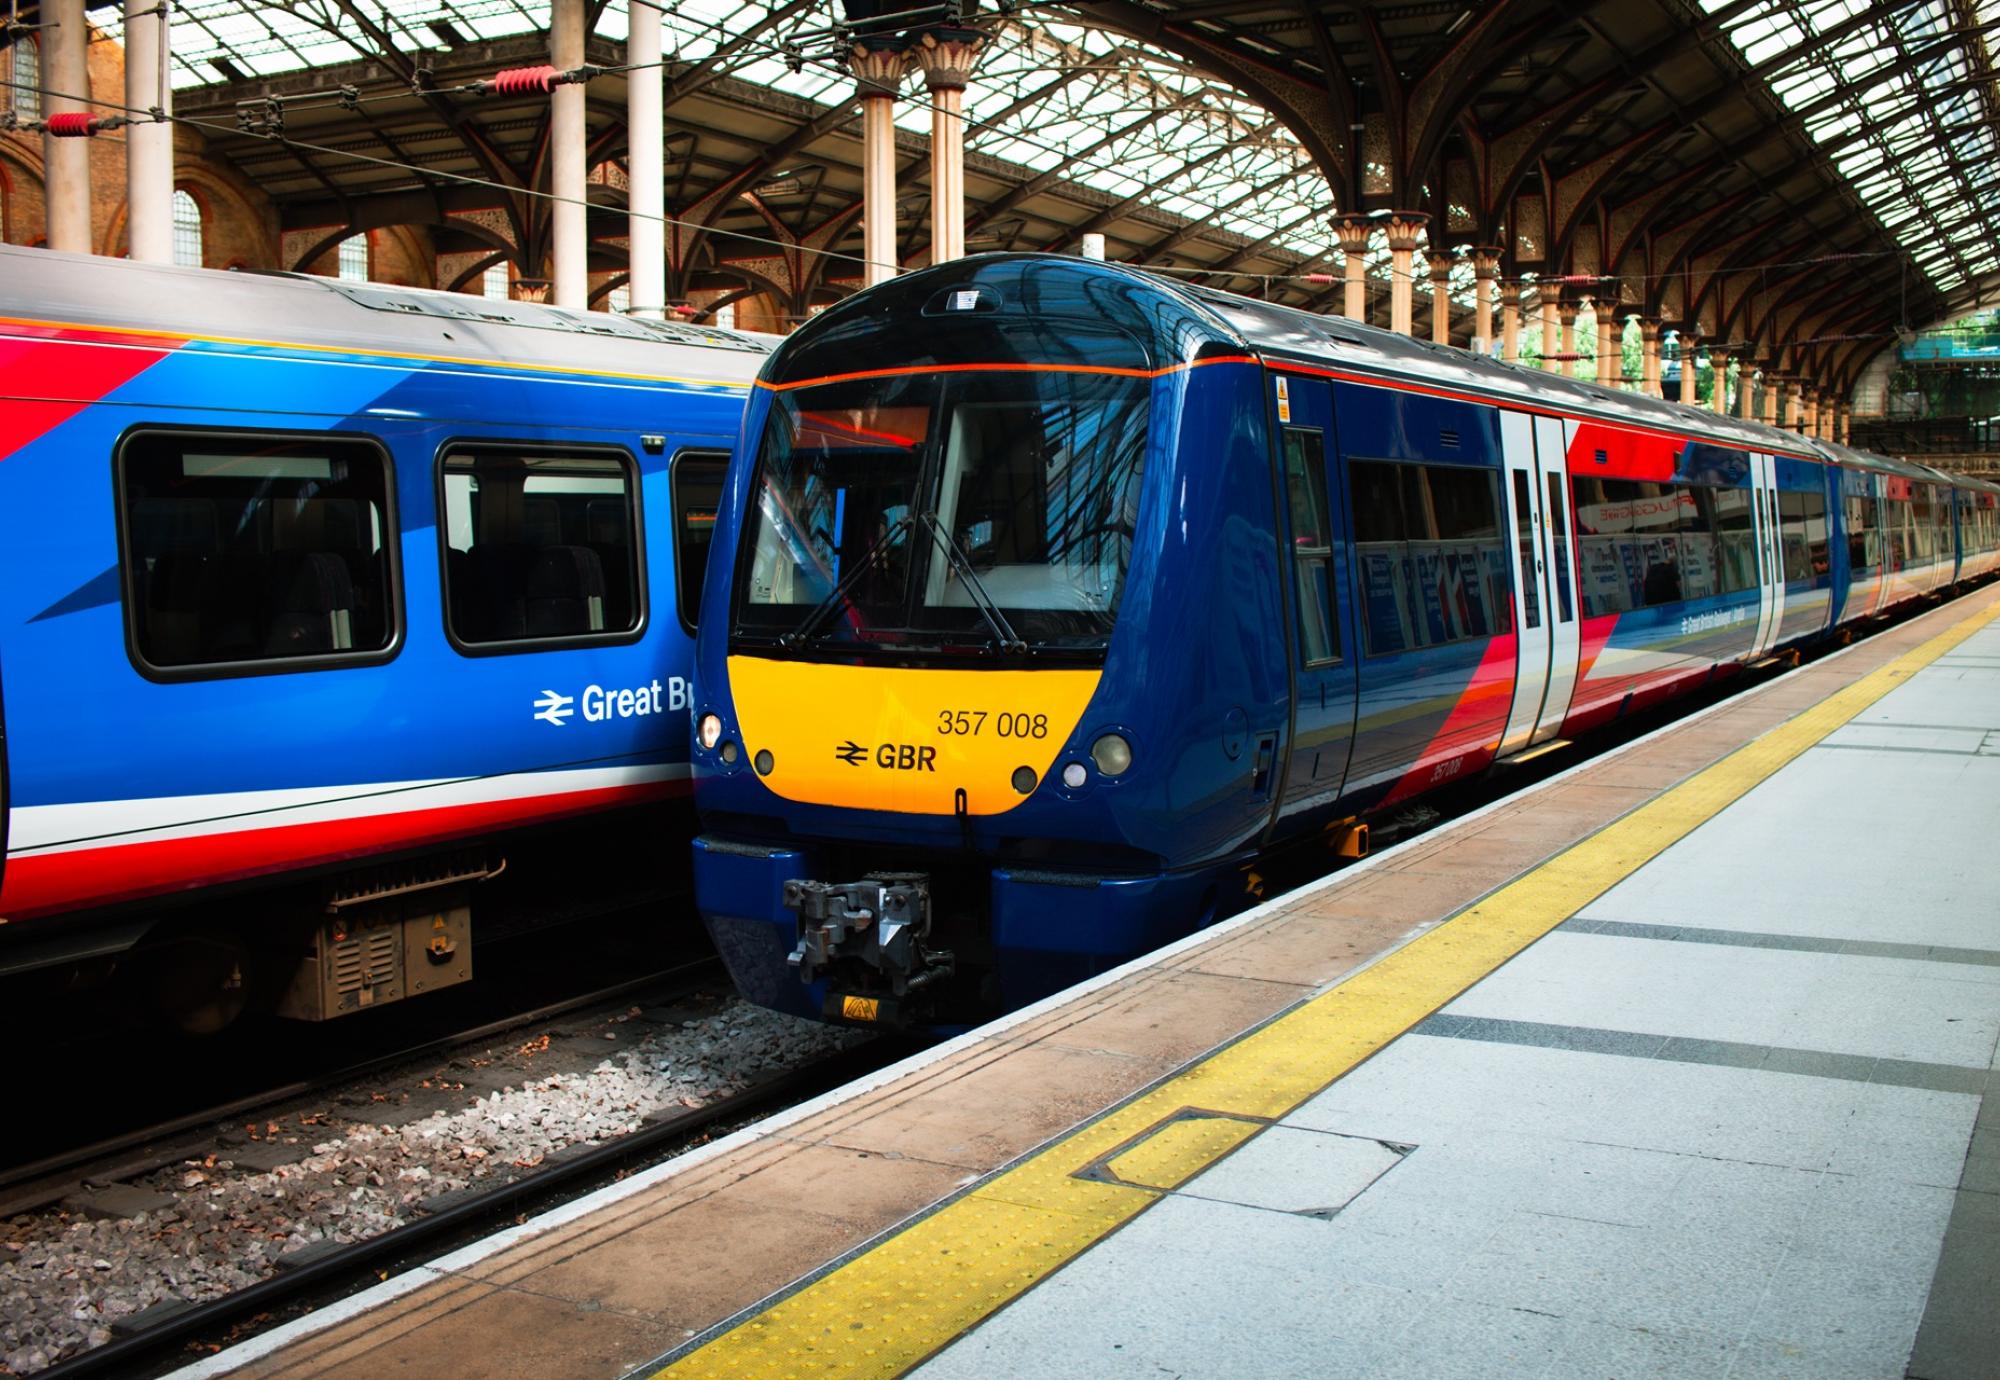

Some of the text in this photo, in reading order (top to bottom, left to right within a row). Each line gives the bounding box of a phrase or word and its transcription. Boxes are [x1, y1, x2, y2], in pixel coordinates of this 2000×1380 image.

[582, 680, 662, 722] Great
[937, 710, 1048, 739] 357 008
[876, 743, 937, 772] GBR
